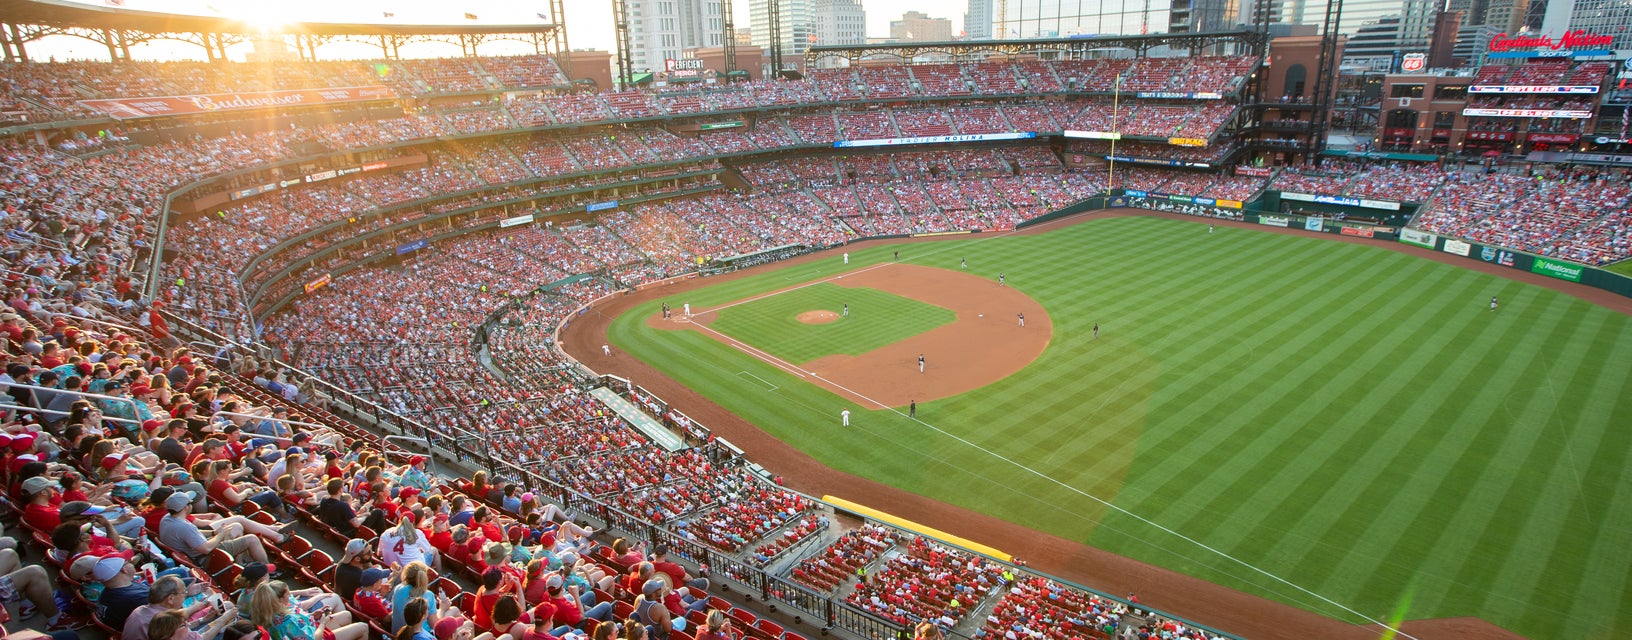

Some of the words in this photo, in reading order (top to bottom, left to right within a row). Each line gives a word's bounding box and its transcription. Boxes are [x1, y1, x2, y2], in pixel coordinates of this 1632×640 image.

[1489, 33, 1553, 51] Cardinals
[1552, 30, 1613, 50] Nation
[667, 59, 704, 71] PERFICIENT
[1404, 60, 1420, 69] 66
[188, 92, 304, 110] Budweiser
[945, 134, 984, 142] MOLINA
[1186, 138, 1203, 147] MAC
[1544, 262, 1580, 275] National
[393, 538, 404, 555] 4
